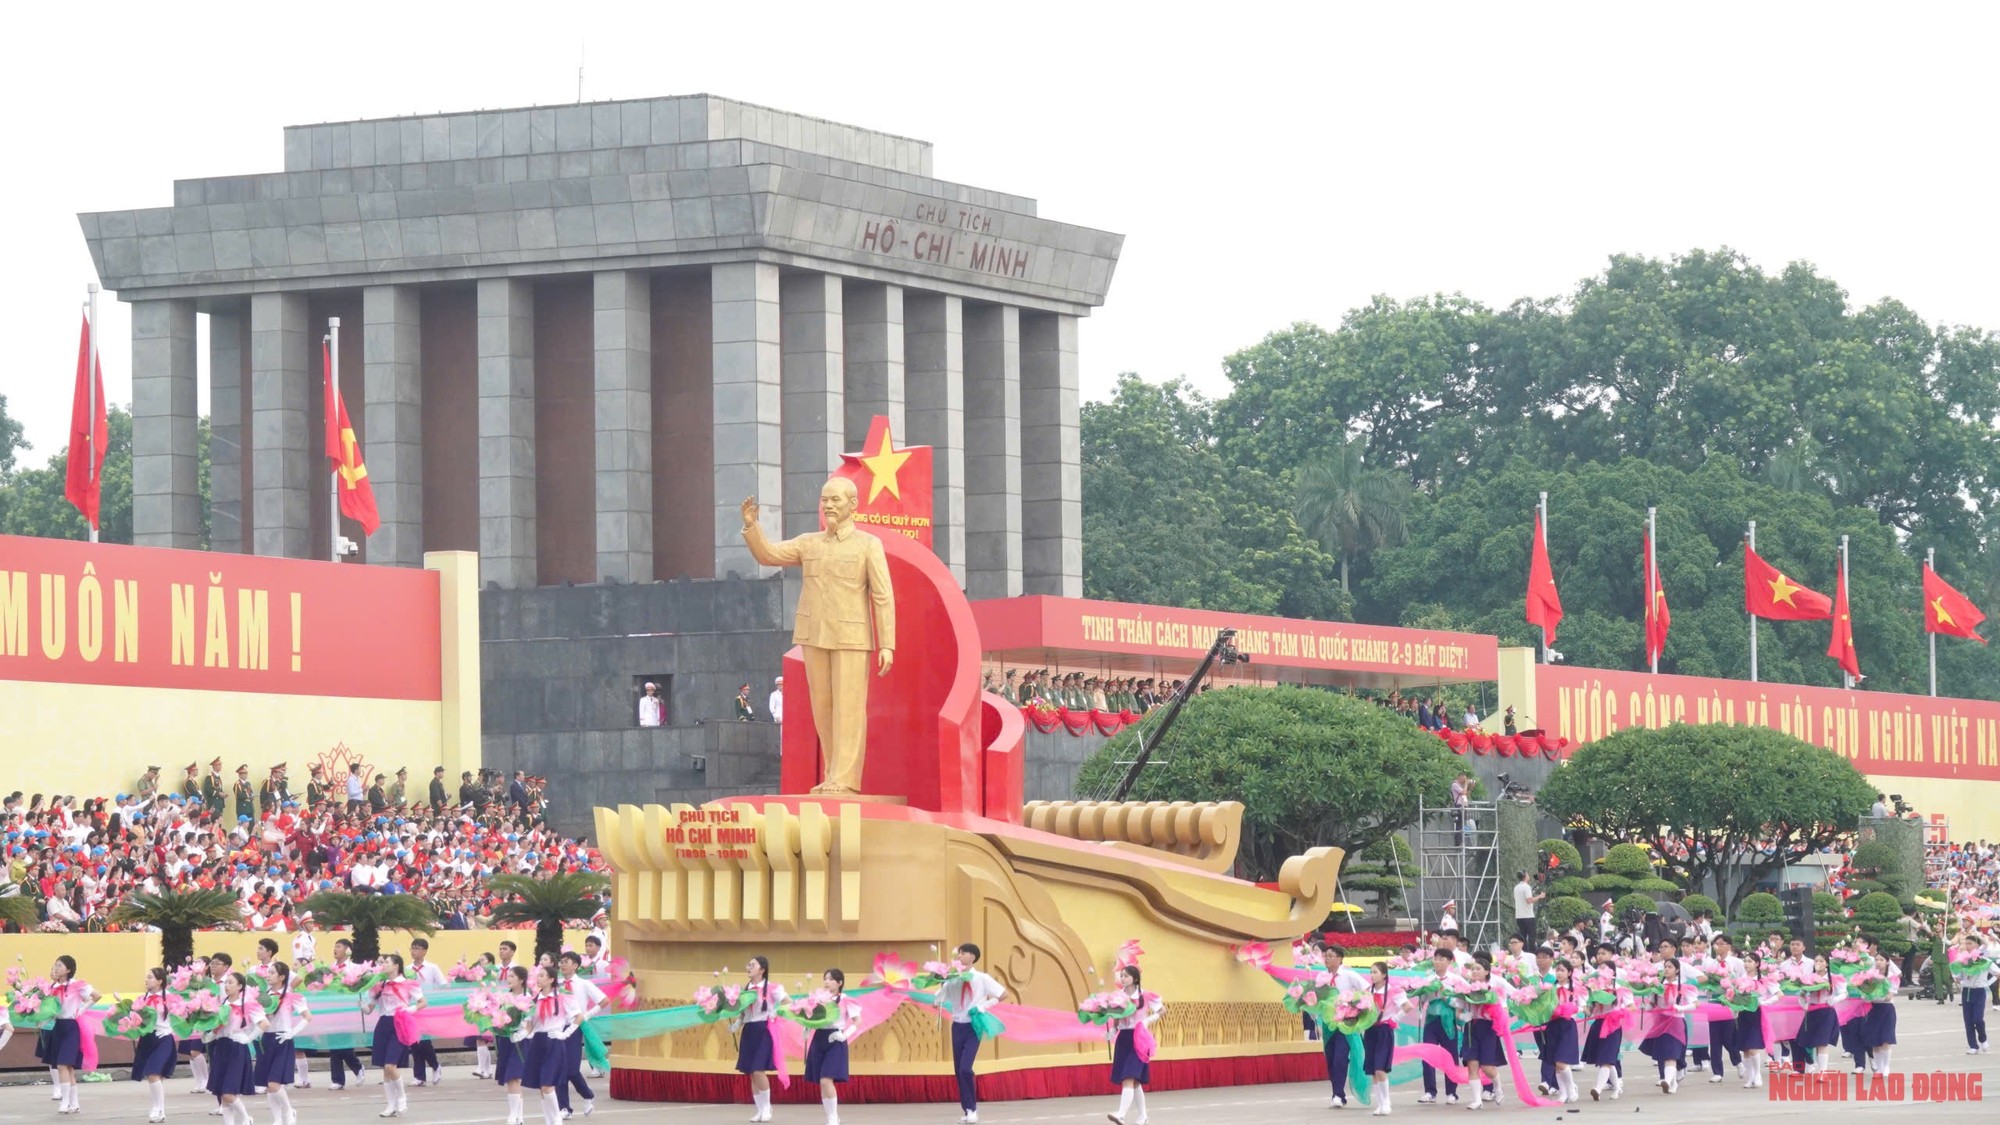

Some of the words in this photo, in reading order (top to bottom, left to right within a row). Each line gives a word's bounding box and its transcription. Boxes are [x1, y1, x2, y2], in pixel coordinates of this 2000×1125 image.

[869, 513, 881, 524] CÓ
[892, 514, 909, 526] QUÝ
[0, 561, 138, 662] MUÔN
[171, 571, 268, 670] NĂM
[1082, 615, 1114, 642] TINH
[1117, 612, 1152, 645] THẦN
[1156, 618, 1189, 648] CÁCH
[1272, 628, 1298, 657] TÁM
[1301, 630, 1316, 658] VÀ
[1319, 631, 1348, 661] QUỐC
[1351, 635, 1389, 664] KHÁNH
[1391, 642, 1412, 666] 2-9
[1415, 638, 1436, 668] BẤT
[1559, 679, 1617, 744] NƯỚC
[1823, 696, 1859, 759] CHỦ
[1869, 705, 1924, 762] NGHĨA
[1932, 707, 1969, 774] VIỆT
[1977, 718, 2000, 766] NA
[666, 822, 685, 843] HỒ
[688, 824, 712, 844] CHÍ
[717, 828, 756, 844] MINH
[680, 806, 705, 822] CHỦ
[708, 810, 739, 825] TỊCH
